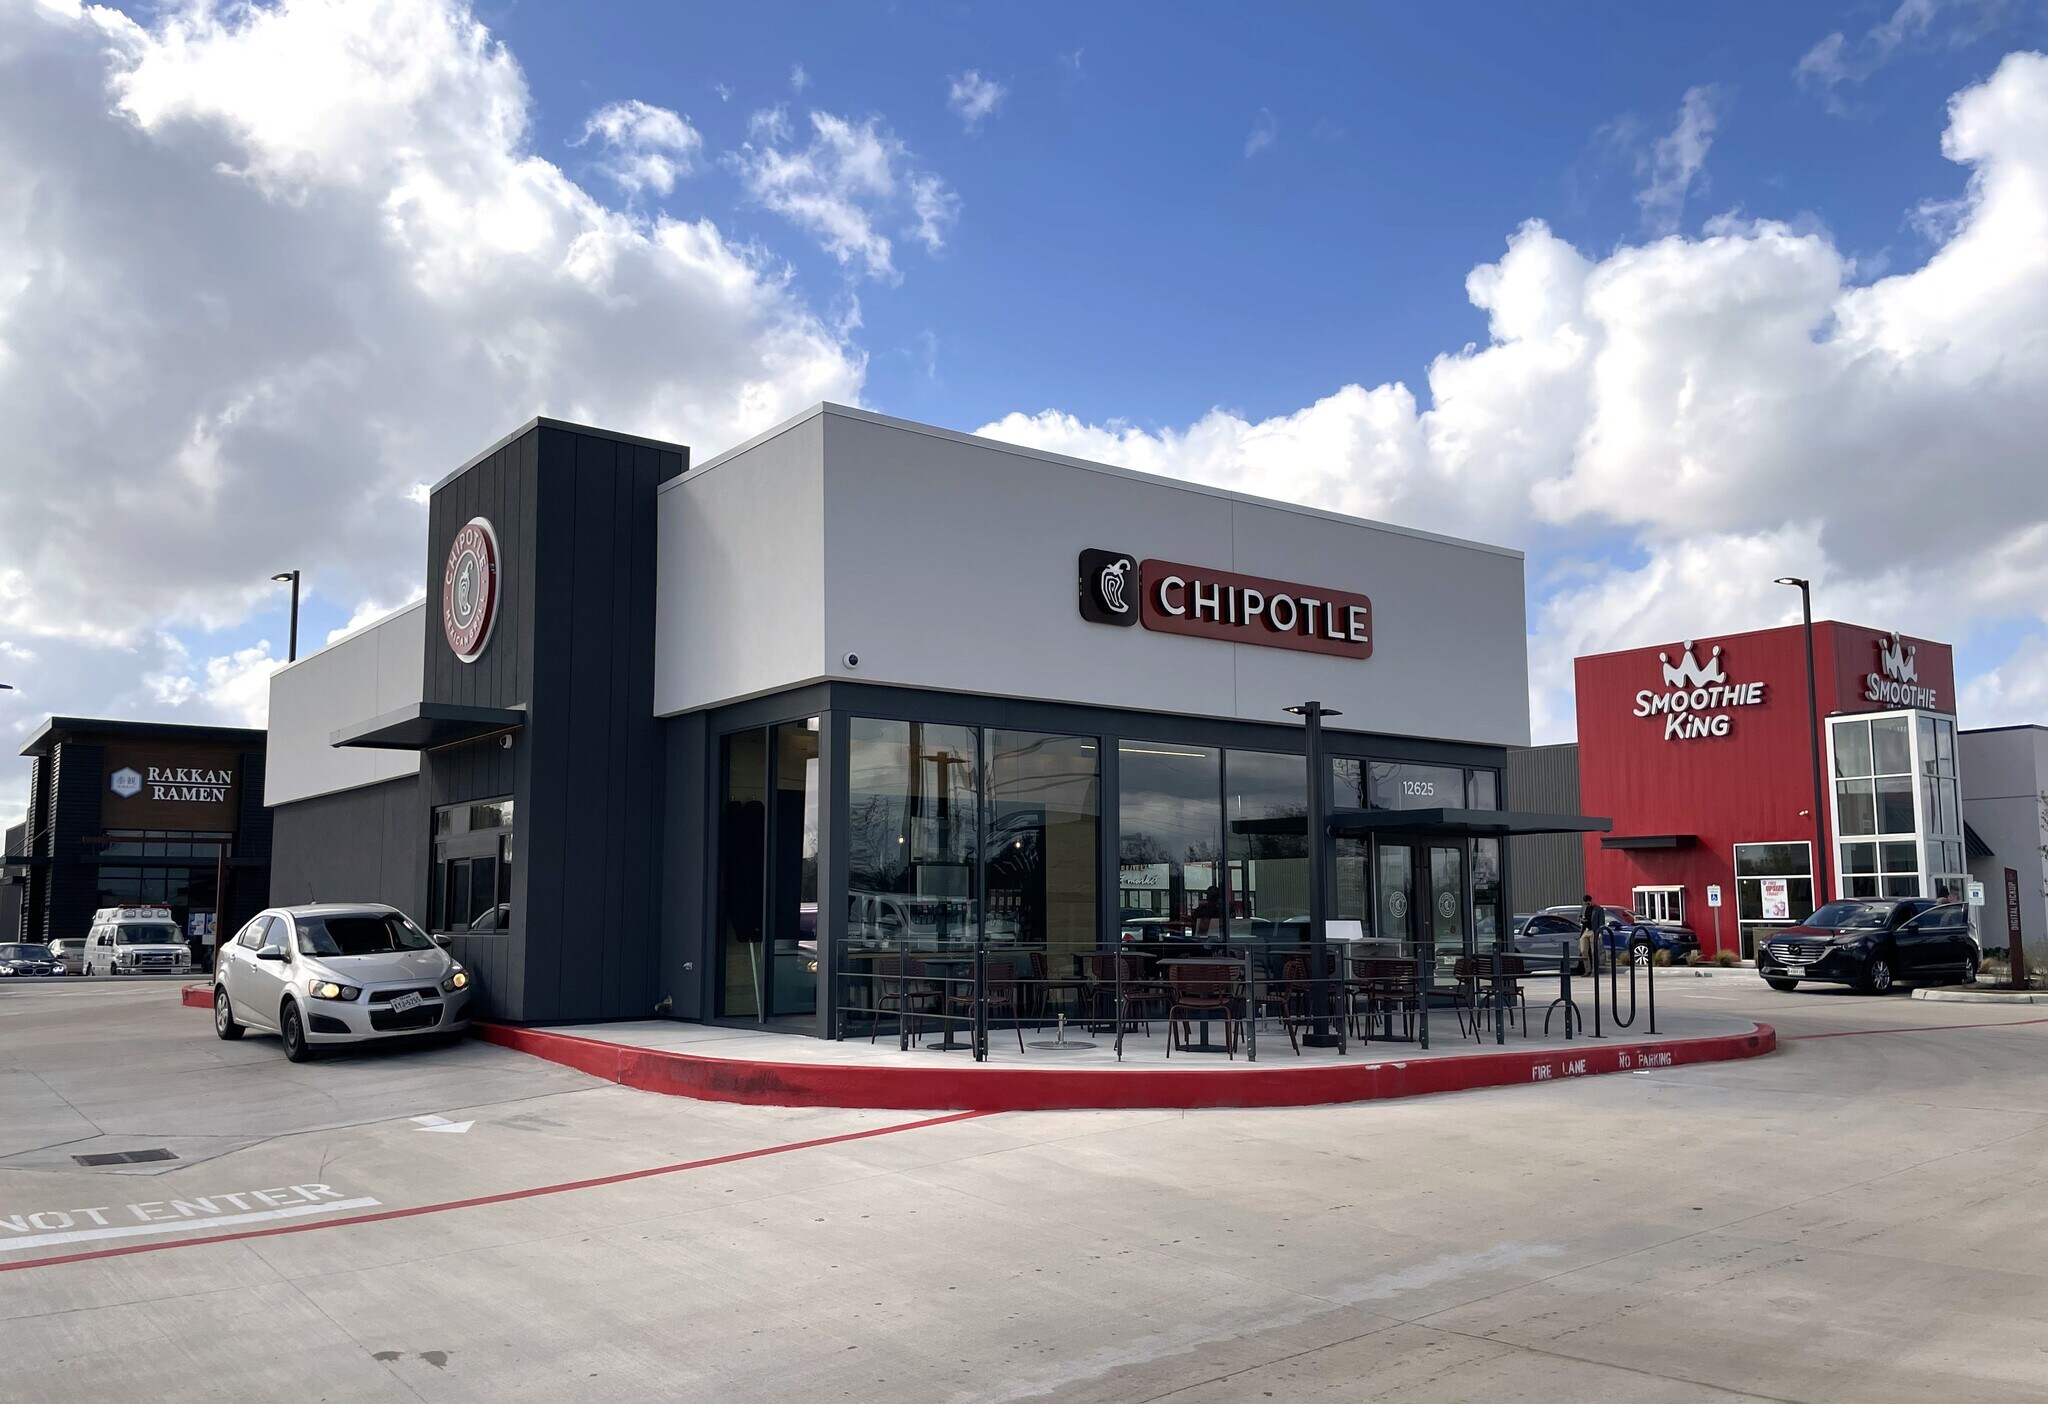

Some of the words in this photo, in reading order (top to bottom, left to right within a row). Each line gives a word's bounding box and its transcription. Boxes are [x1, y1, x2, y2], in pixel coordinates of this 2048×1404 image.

[446, 529, 487, 585] CHIPOTLE
[445, 608, 469, 646] MEXICAN
[469, 595, 486, 637] GRILL
[1160, 575, 1369, 643] CHIPOTLE
[1633, 682, 1764, 717] SMOOTHIE
[1869, 673, 1937, 709] SMOOTHIE
[147, 766, 233, 784] RAKKAN
[1403, 781, 1434, 797] 12625
[152, 786, 226, 802] RAMEN
[2007, 882, 2017, 905] PICKUP
[2009, 907, 2020, 931] DIGITAL
[1532, 1064, 1552, 1080] FIRE
[1562, 1059, 1587, 1075] LANE
[1618, 1054, 1631, 1068] NO
[1638, 1052, 1672, 1067] PARKING
[0, 1206, 109, 1232] NOT
[126, 1183, 345, 1221] ENTER
